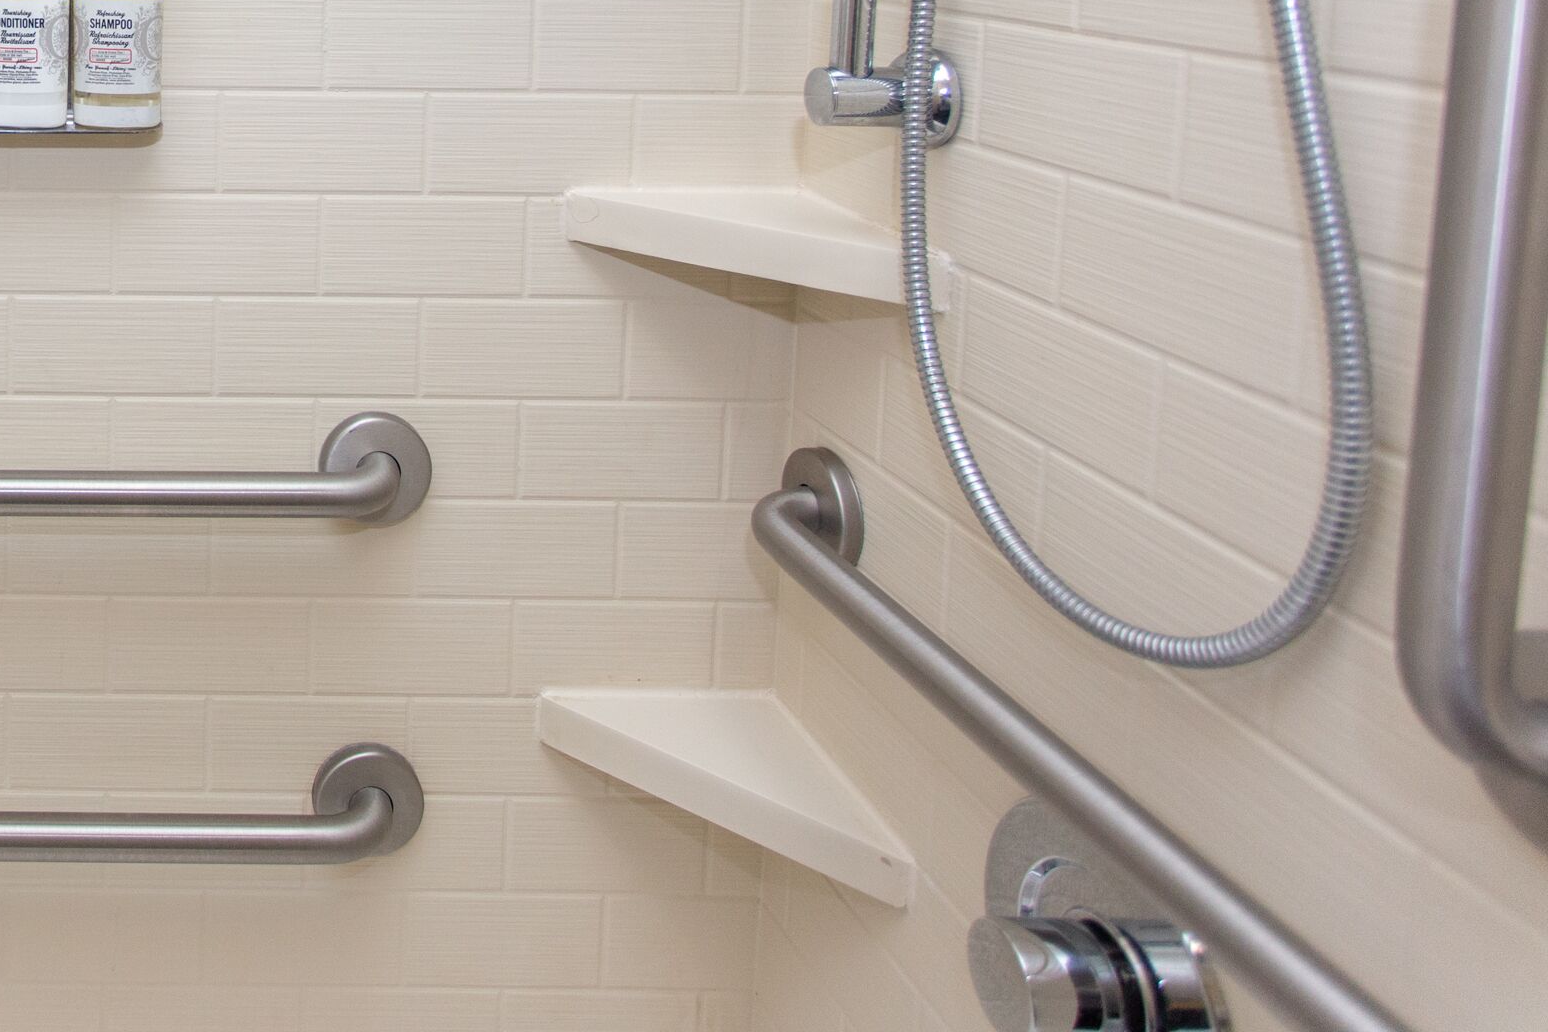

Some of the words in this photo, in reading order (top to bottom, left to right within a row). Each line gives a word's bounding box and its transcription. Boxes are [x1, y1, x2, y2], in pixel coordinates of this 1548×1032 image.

[2, 8, 32, 18] Nourishing
[96, 10, 126, 19] Refreshing
[89, 18, 133, 29] SHAMPOO
[92, 38, 129, 48] Shampooing
